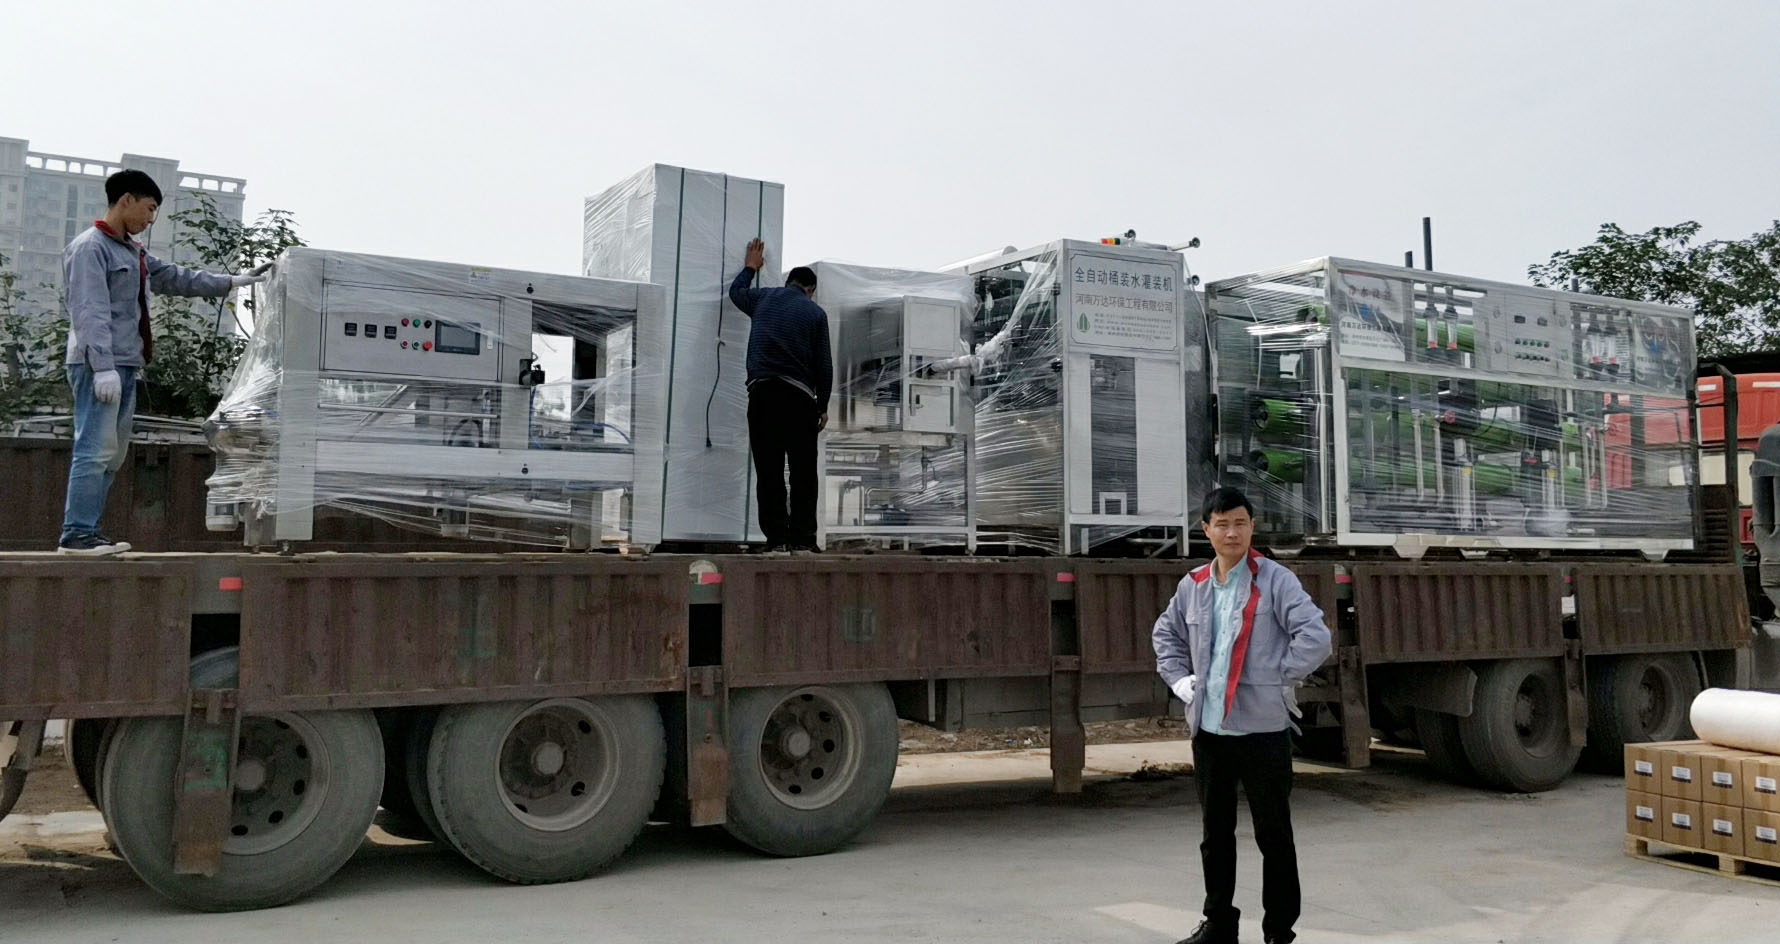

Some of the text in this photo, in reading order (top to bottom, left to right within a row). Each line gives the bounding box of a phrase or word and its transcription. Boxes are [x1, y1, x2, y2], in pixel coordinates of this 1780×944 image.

[1074, 266, 1173, 292] 全自动桶装水灌装机
[1074, 293, 1173, 313] 河南万达环保工程有限公司
